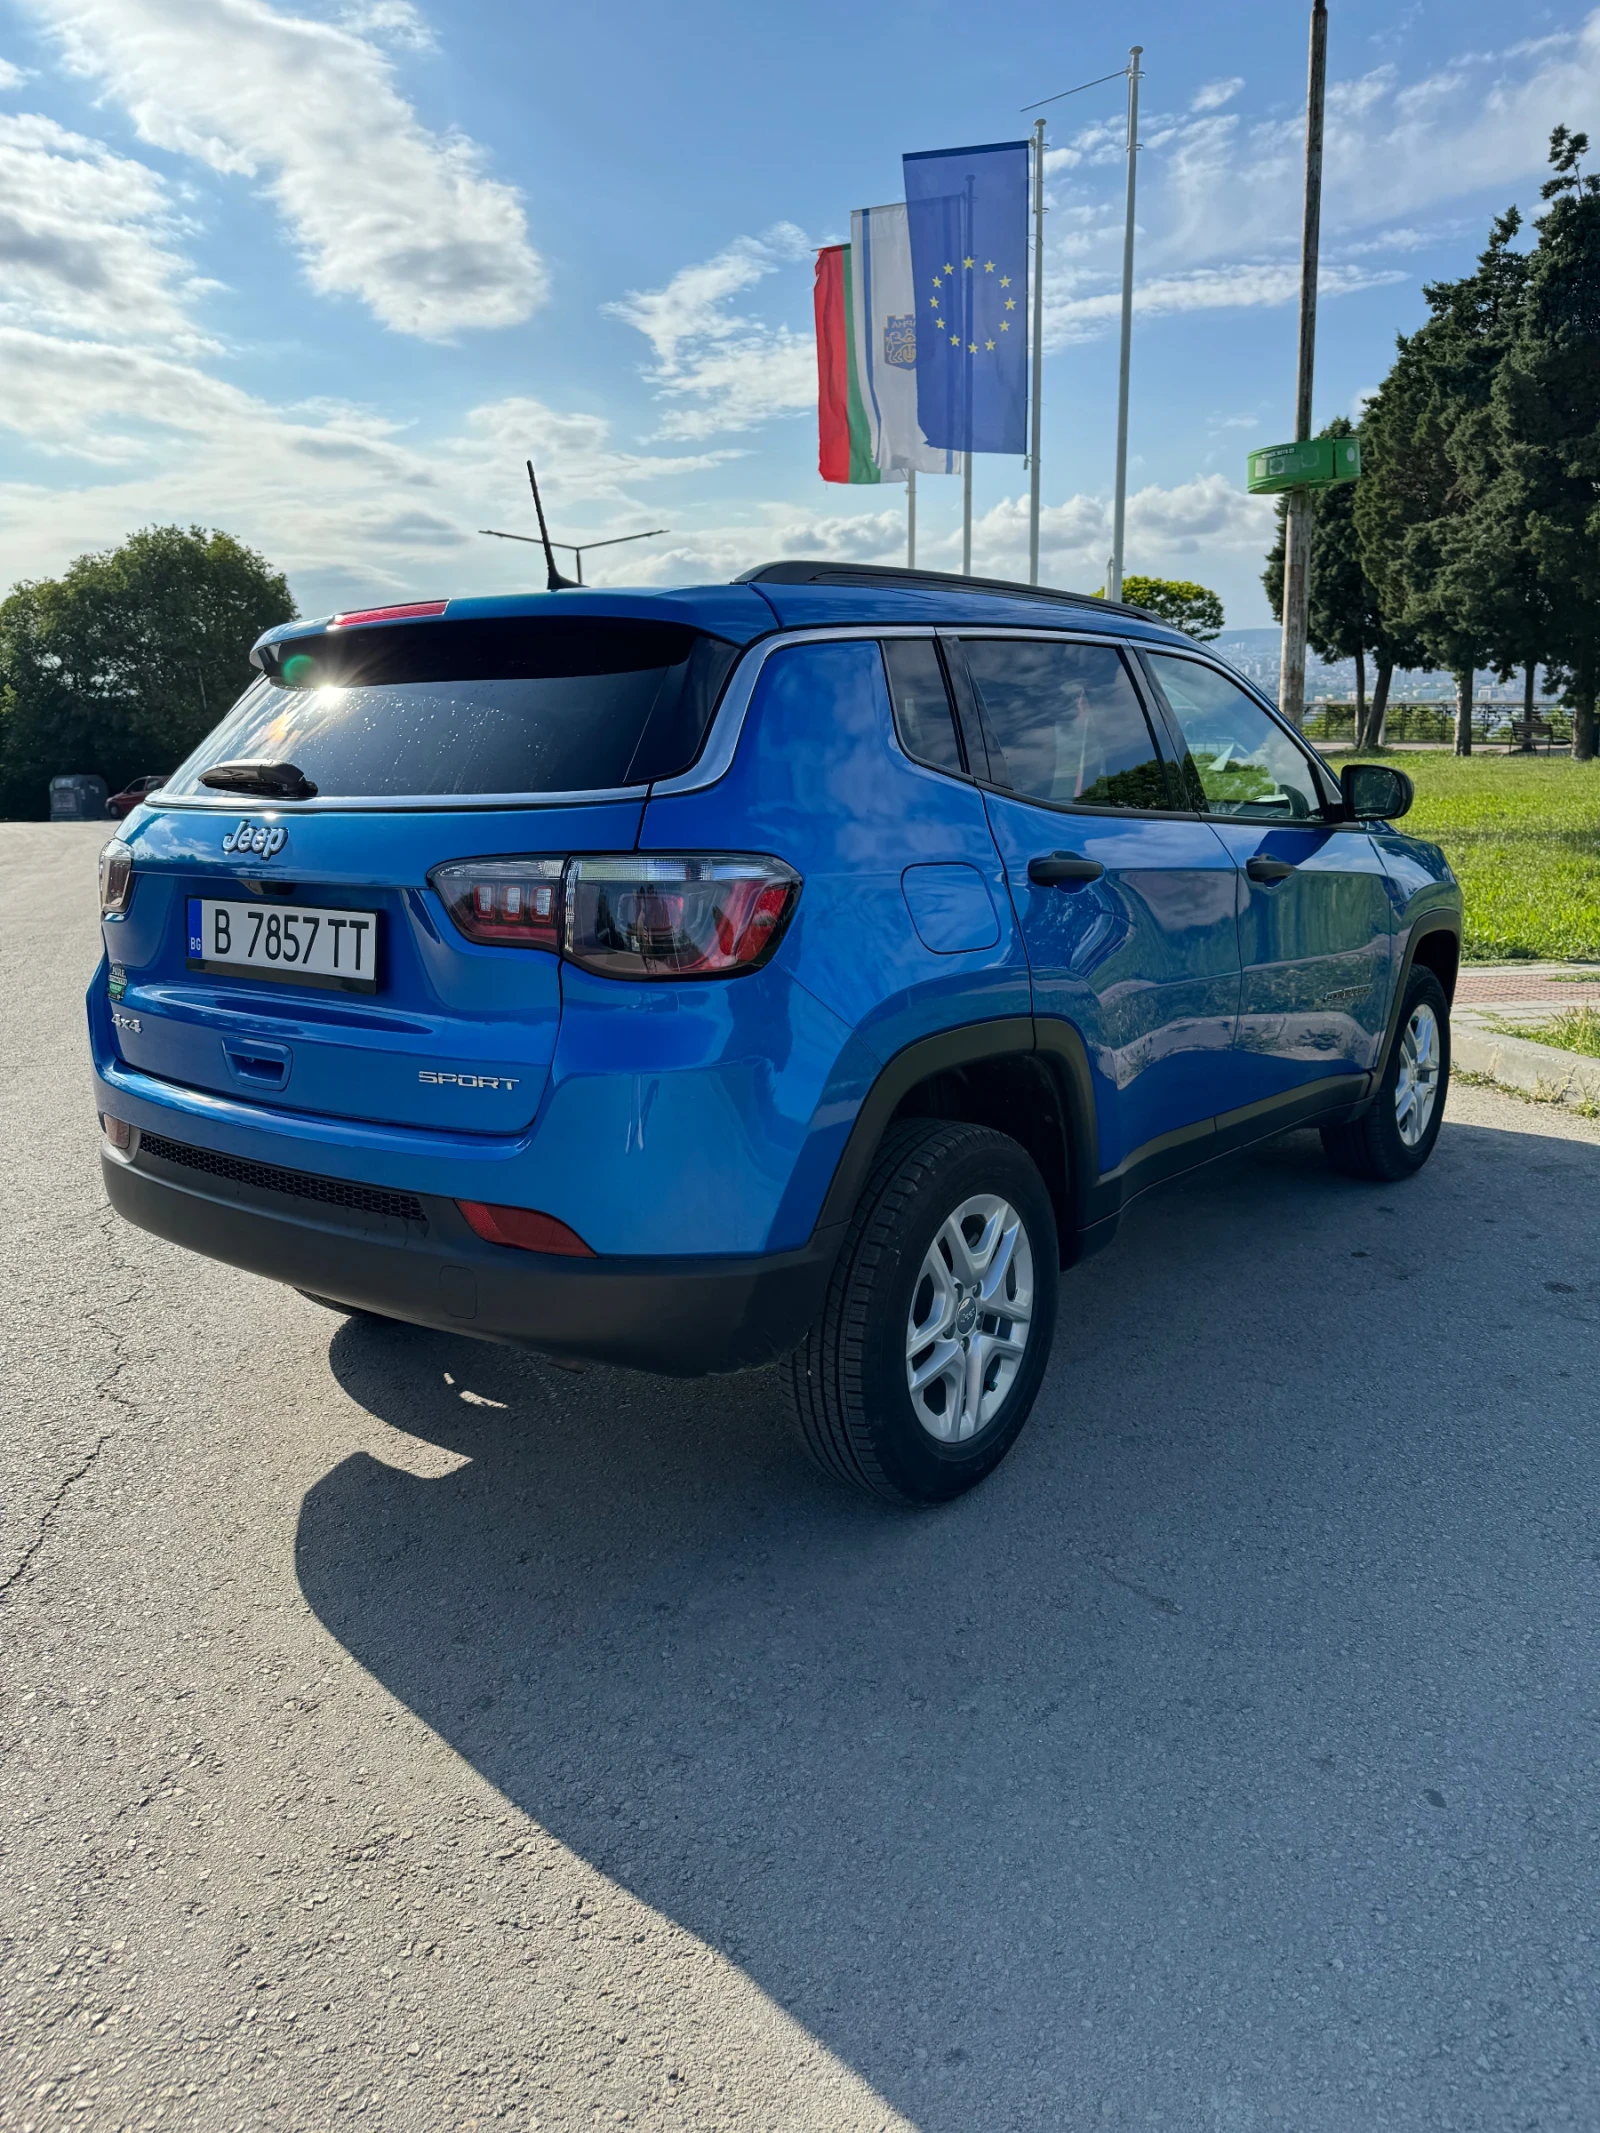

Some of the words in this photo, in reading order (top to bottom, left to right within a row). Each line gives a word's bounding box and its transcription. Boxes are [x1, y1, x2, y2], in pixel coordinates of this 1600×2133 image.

[222, 819, 289, 861] Jeep
[190, 937, 202, 951] BG
[215, 908, 231, 954] B
[247, 911, 320, 964] 7857
[328, 919, 370, 971] TT
[418, 1070, 520, 1091] SPORT
